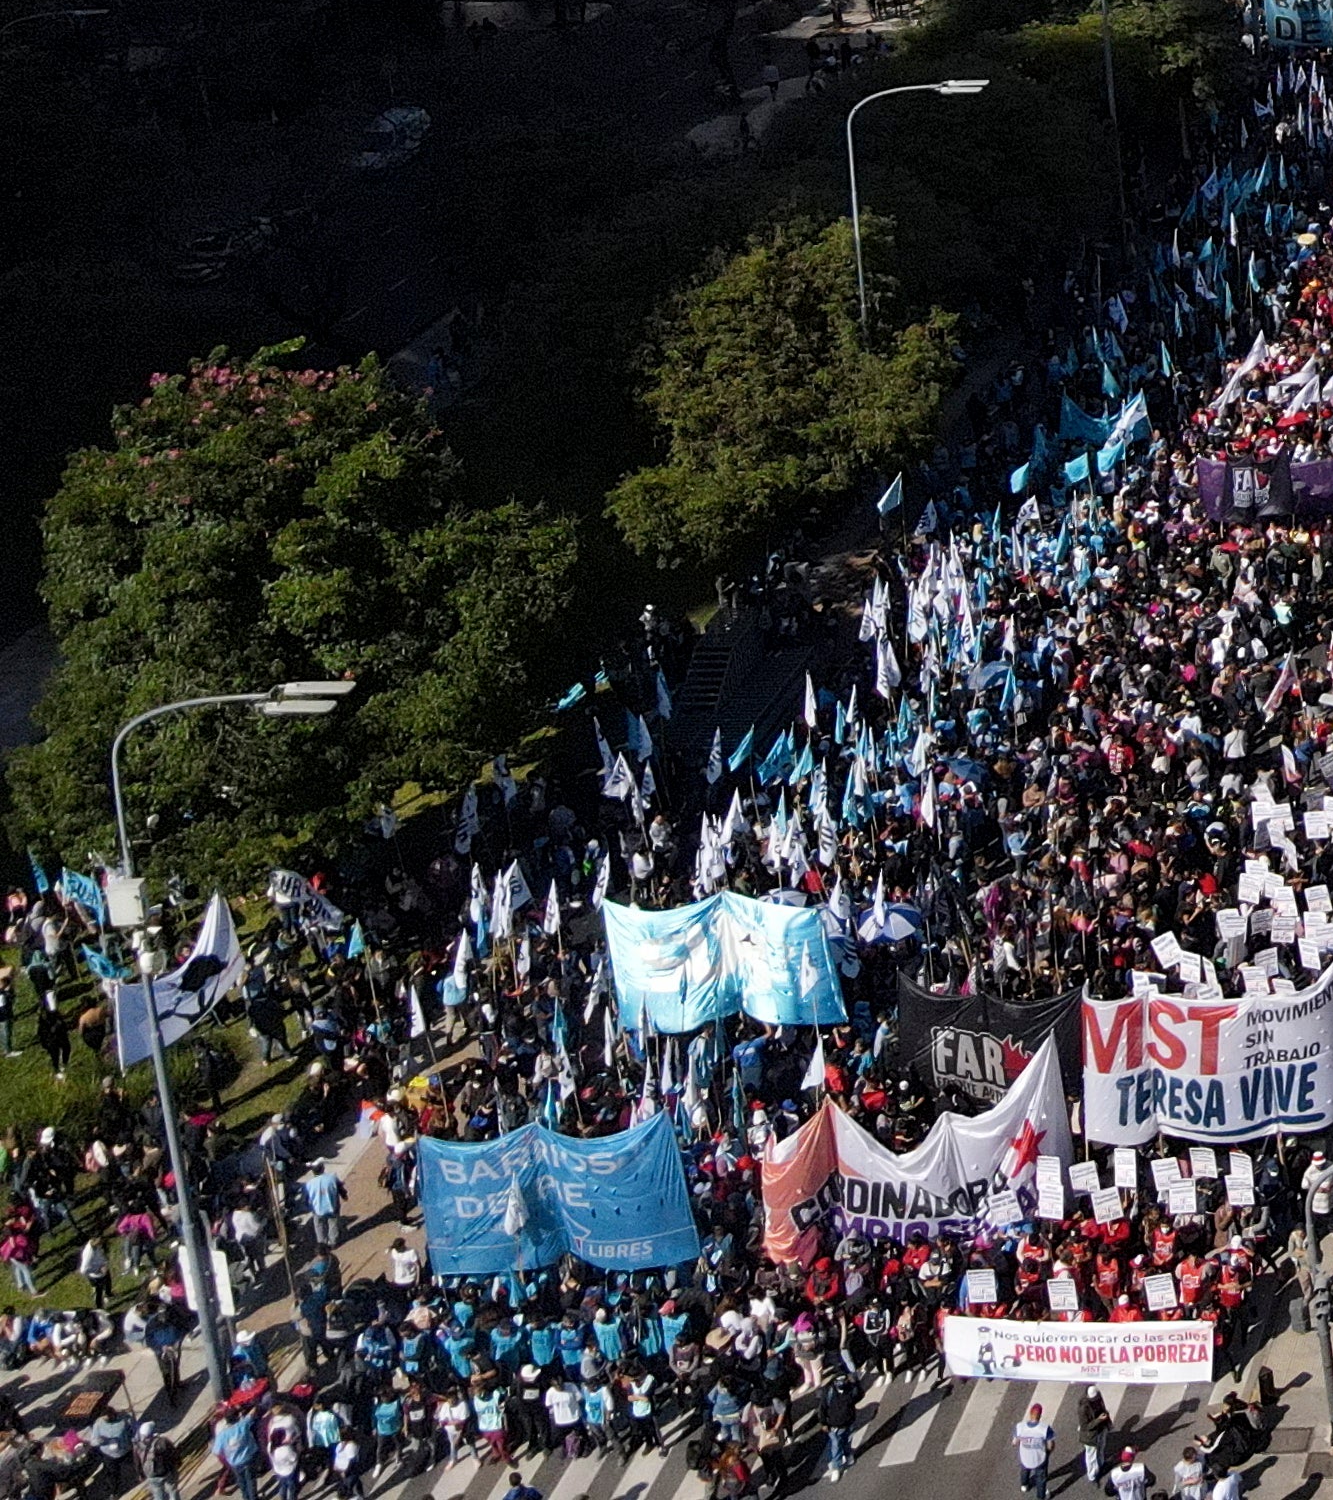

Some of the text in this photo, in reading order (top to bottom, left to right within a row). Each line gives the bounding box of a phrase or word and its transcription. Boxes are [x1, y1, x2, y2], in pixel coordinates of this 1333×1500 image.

[1275, 16, 1322, 44] DE
[1081, 1000, 1238, 1076] MST
[1245, 1029, 1274, 1049] SIN
[933, 1026, 1006, 1087] FAR
[1244, 1041, 1321, 1070] TRABAJO
[1115, 1061, 1318, 1128] TERESA VIVE
[589, 1240, 652, 1258] LIBRES
[995, 1330, 1208, 1346] Nos quieren sacar de las calles
[1014, 1343, 1209, 1365] PERO NO DE LA POBREZA
